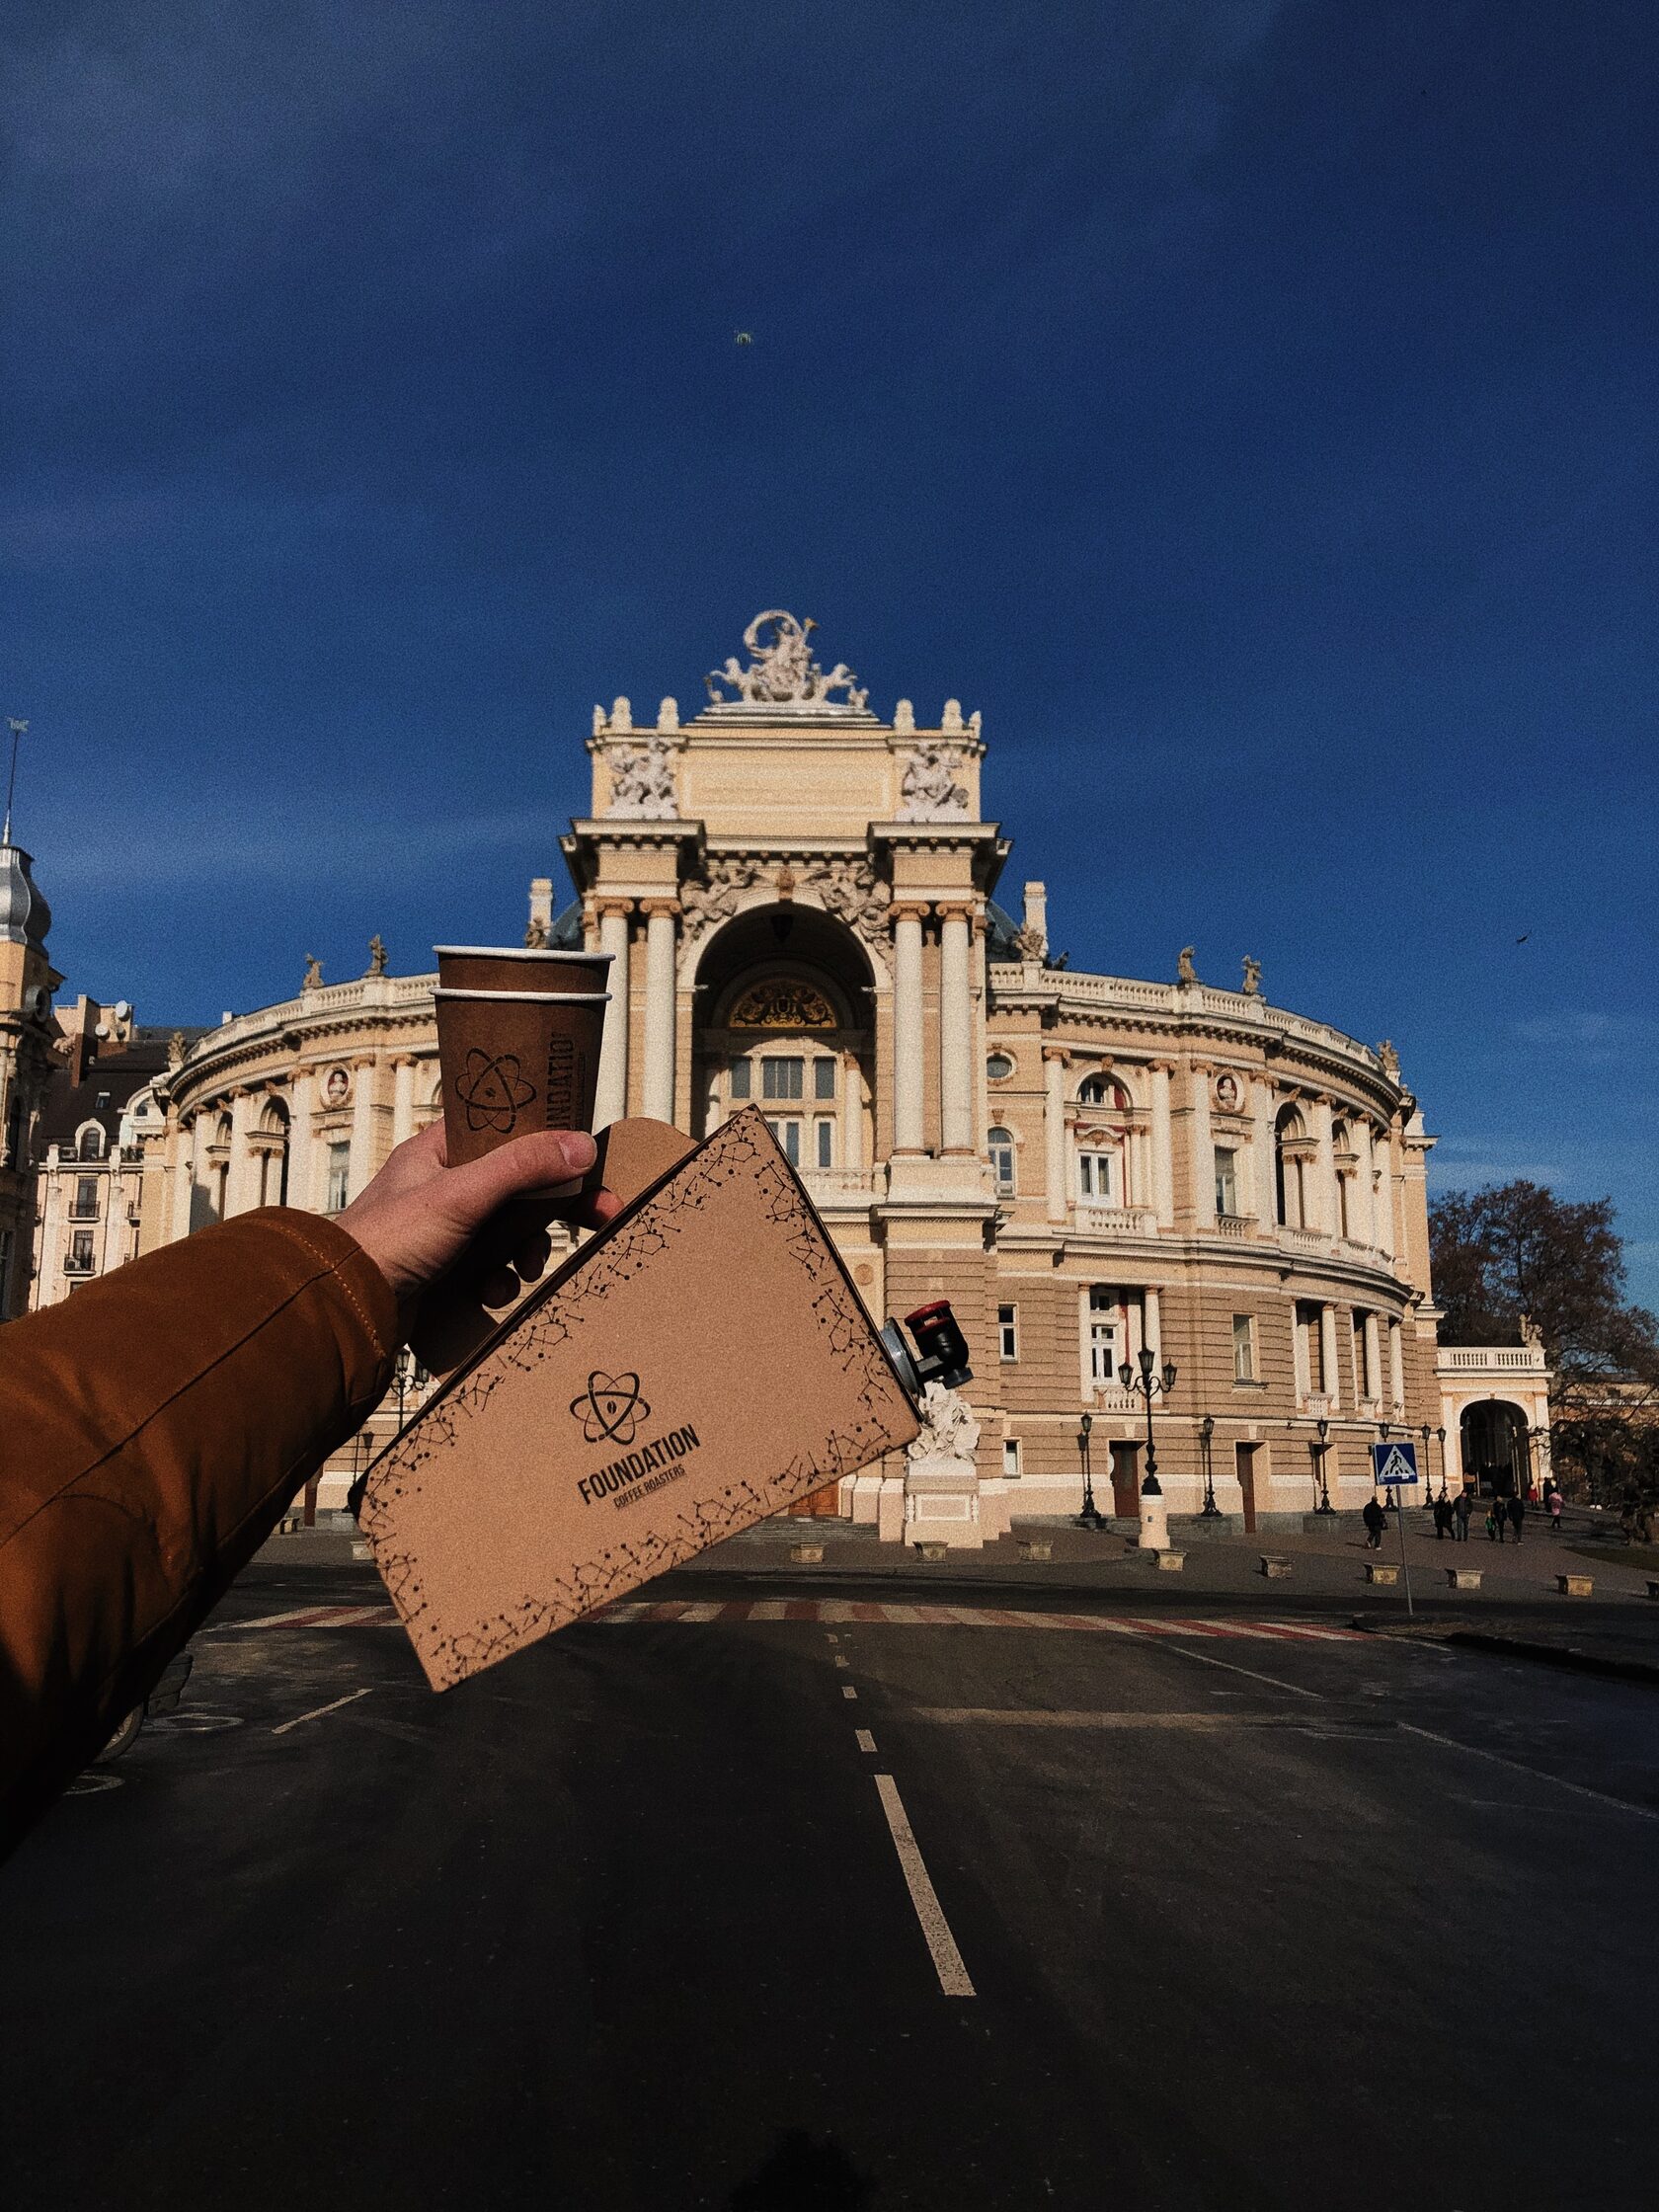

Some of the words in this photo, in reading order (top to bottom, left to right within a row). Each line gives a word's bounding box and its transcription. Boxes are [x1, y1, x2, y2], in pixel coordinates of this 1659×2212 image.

[577, 1423, 701, 1505] FOUNDATION
[613, 1485, 645, 1509] COFFEE
[645, 1463, 685, 1492] ROASTERS
